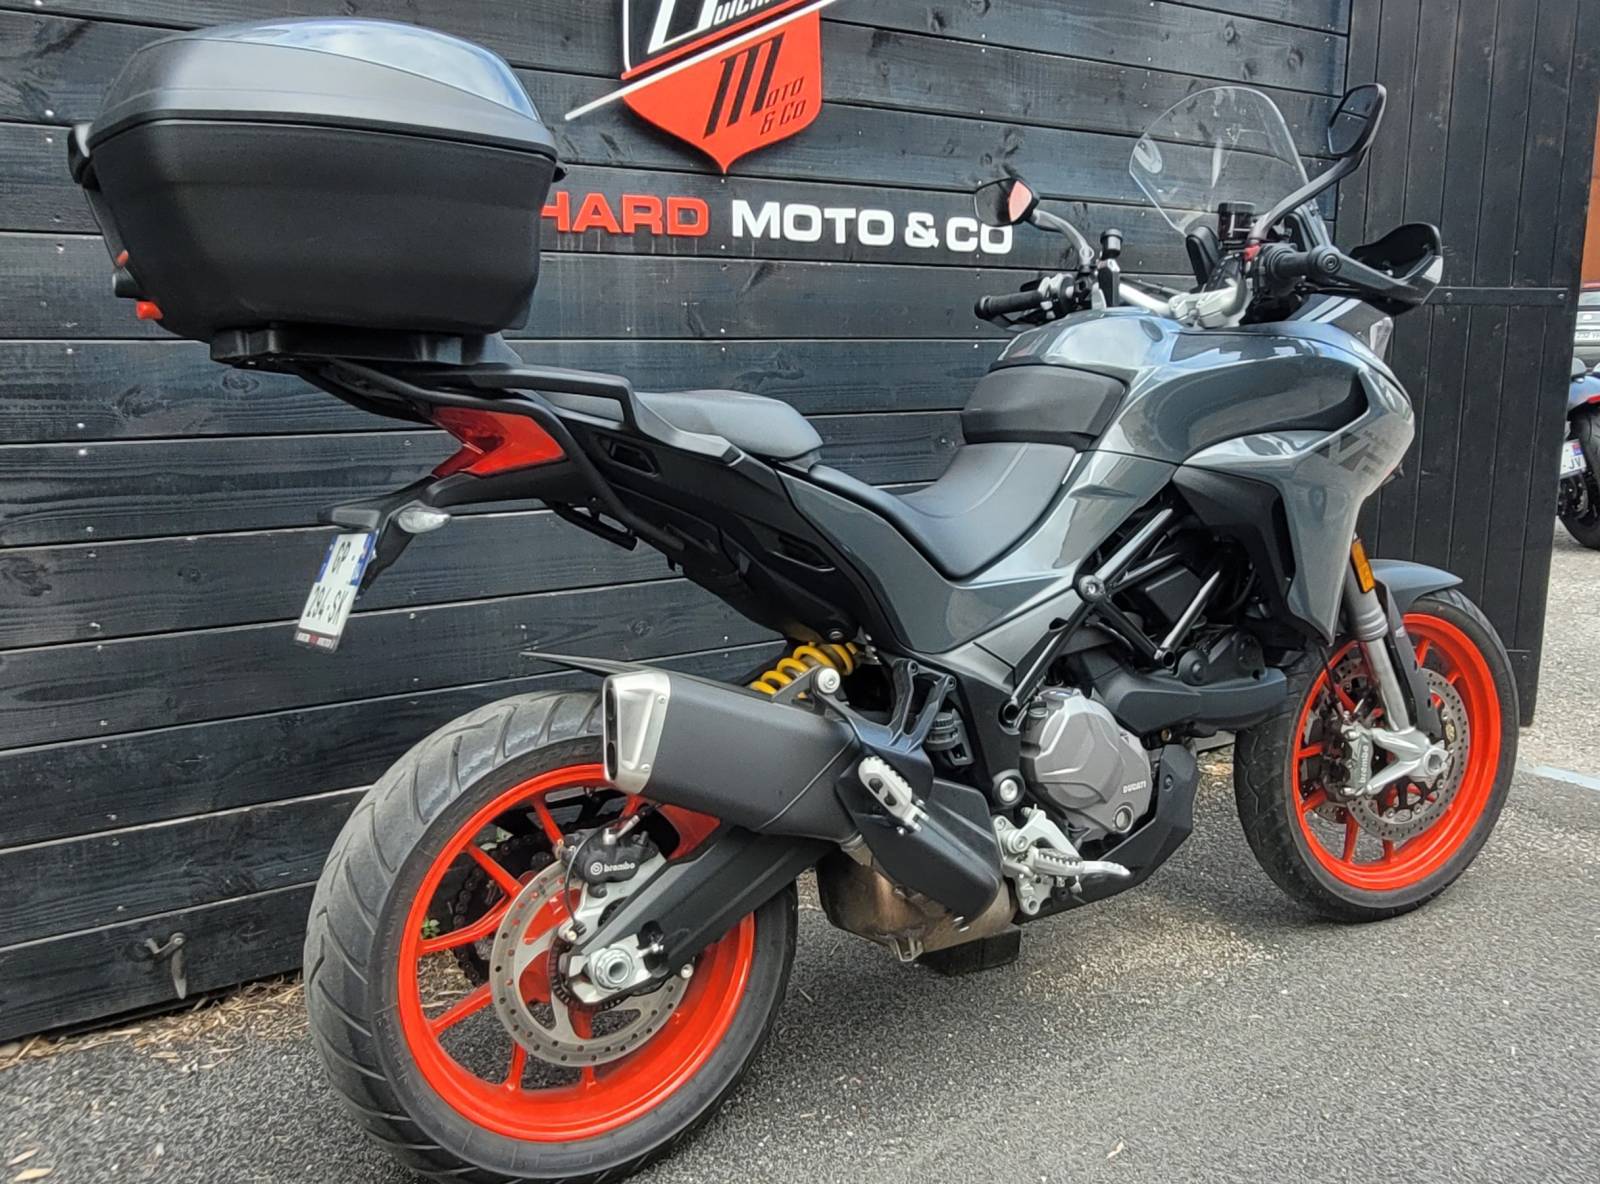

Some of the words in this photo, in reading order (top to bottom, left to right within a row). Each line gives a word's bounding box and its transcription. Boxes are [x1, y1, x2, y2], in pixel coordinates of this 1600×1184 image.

[732, 199, 895, 246] MOTO
[905, 212, 940, 248] &
[946, 216, 1014, 254] CO
[1359, 744, 1369, 784] brembo
[1122, 780, 1147, 794] DUCATI
[603, 861, 636, 873] brembo
